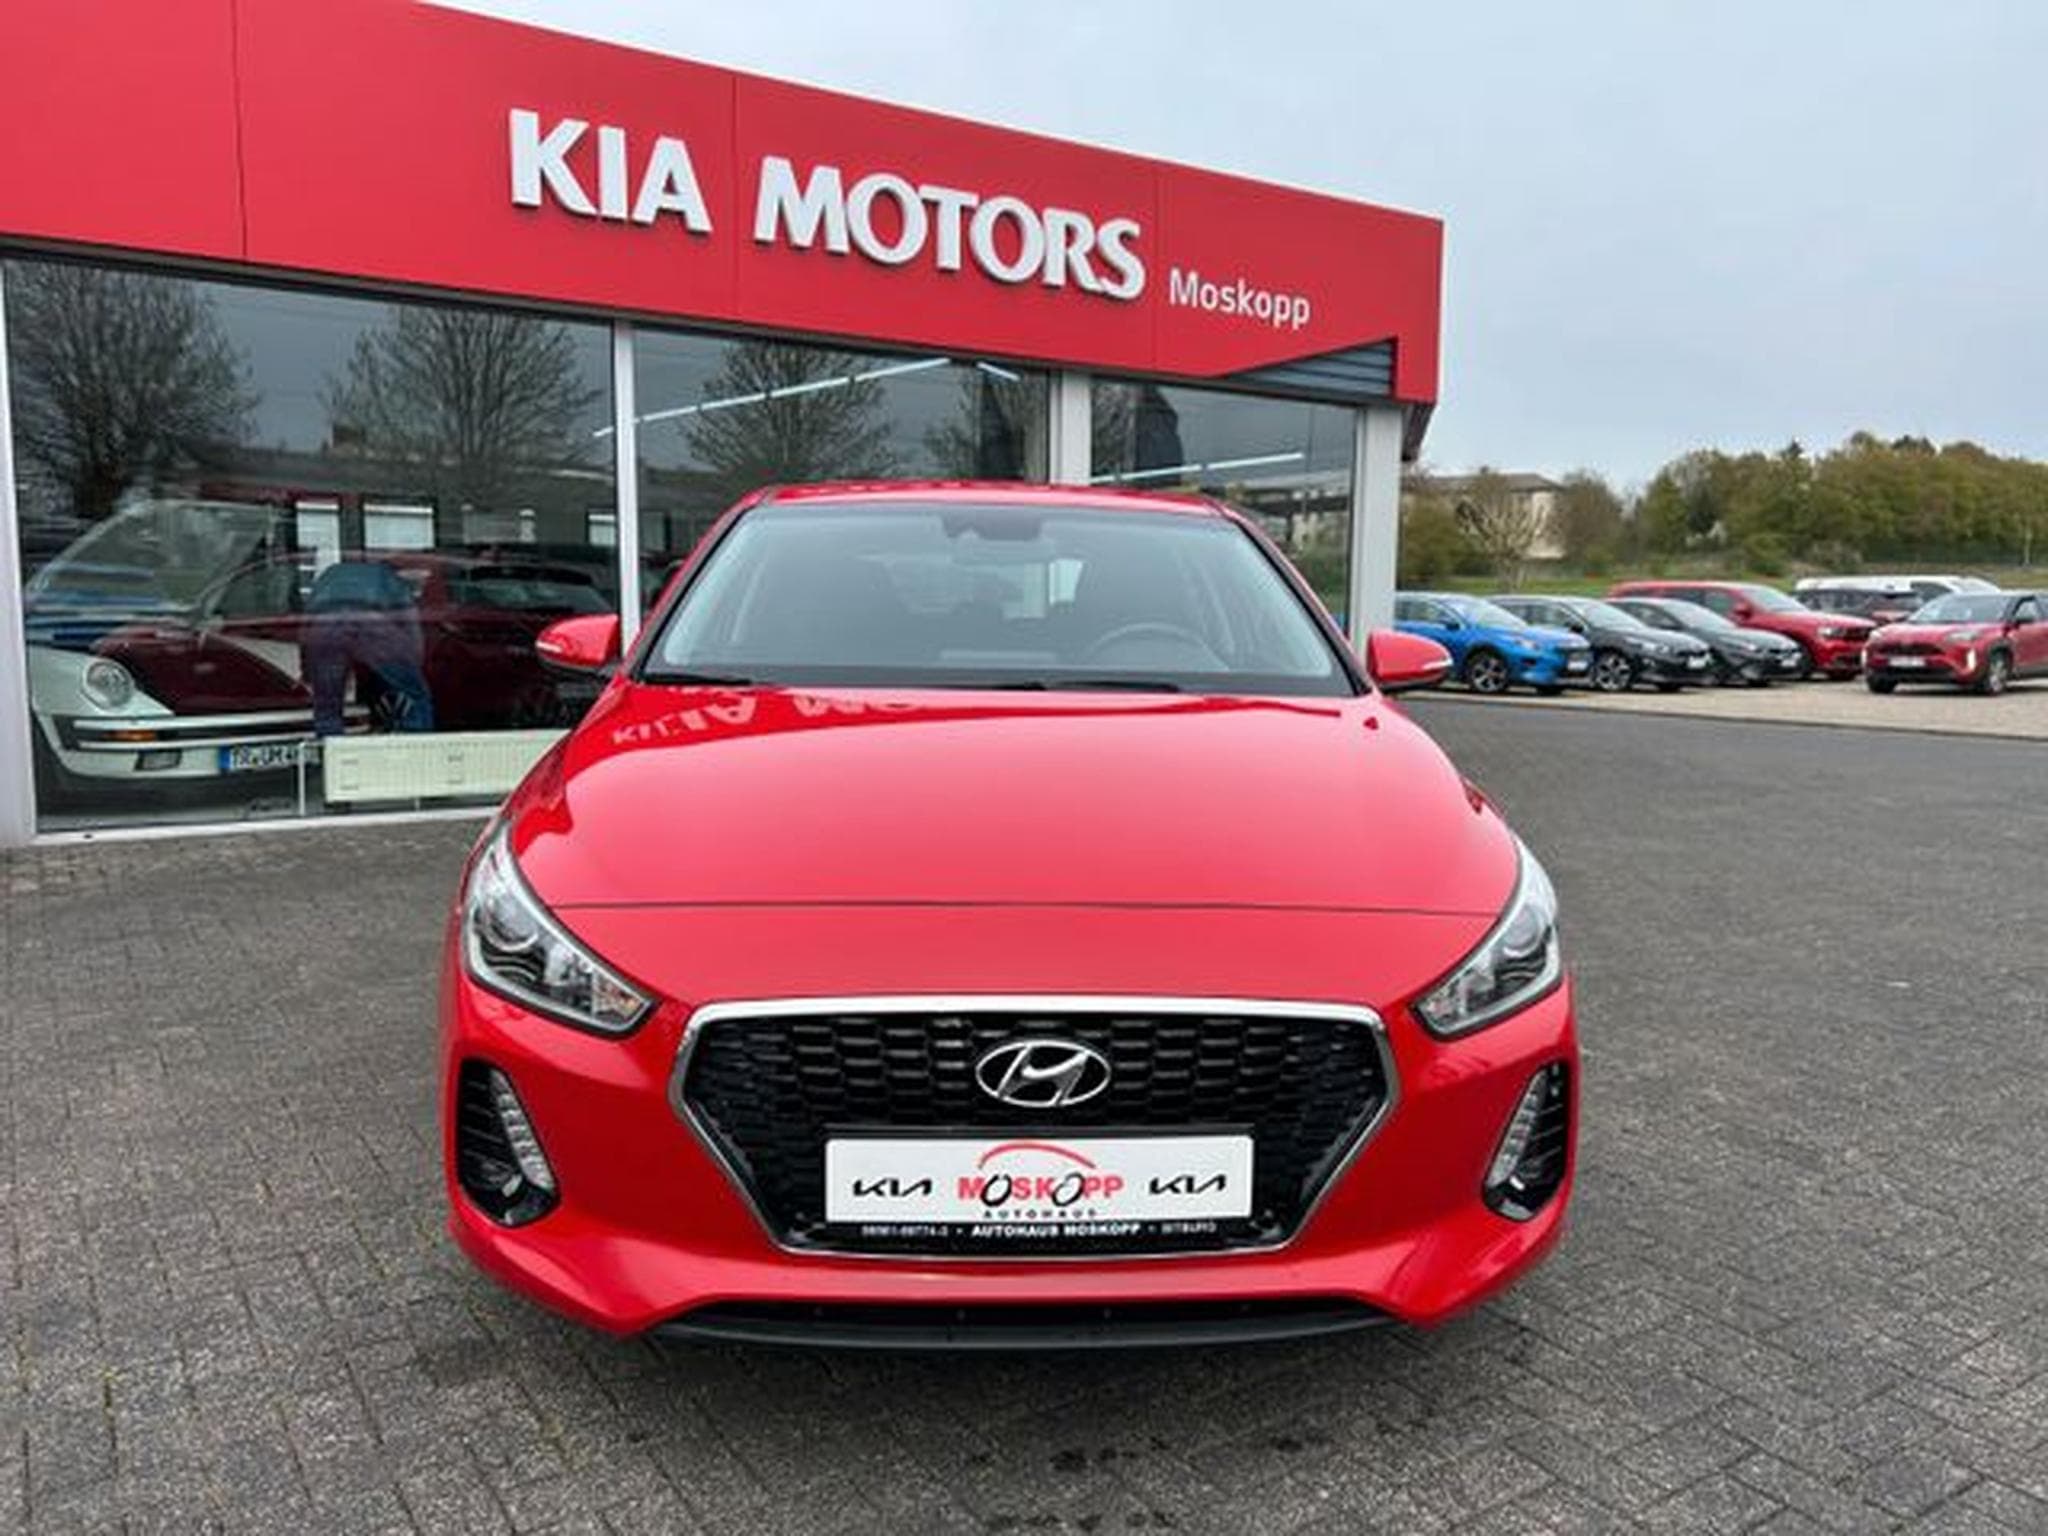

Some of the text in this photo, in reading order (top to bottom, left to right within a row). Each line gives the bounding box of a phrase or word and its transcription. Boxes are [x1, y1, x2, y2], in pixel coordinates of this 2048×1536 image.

[508, 108, 1147, 302] KIA MOTORS
[1168, 266, 1312, 328] Moskopp
[957, 1172, 1125, 1208] MOSKOPP
[971, 1225, 1059, 1238] AUTOHAUS
[1063, 1223, 1142, 1236] MOSKOPP
